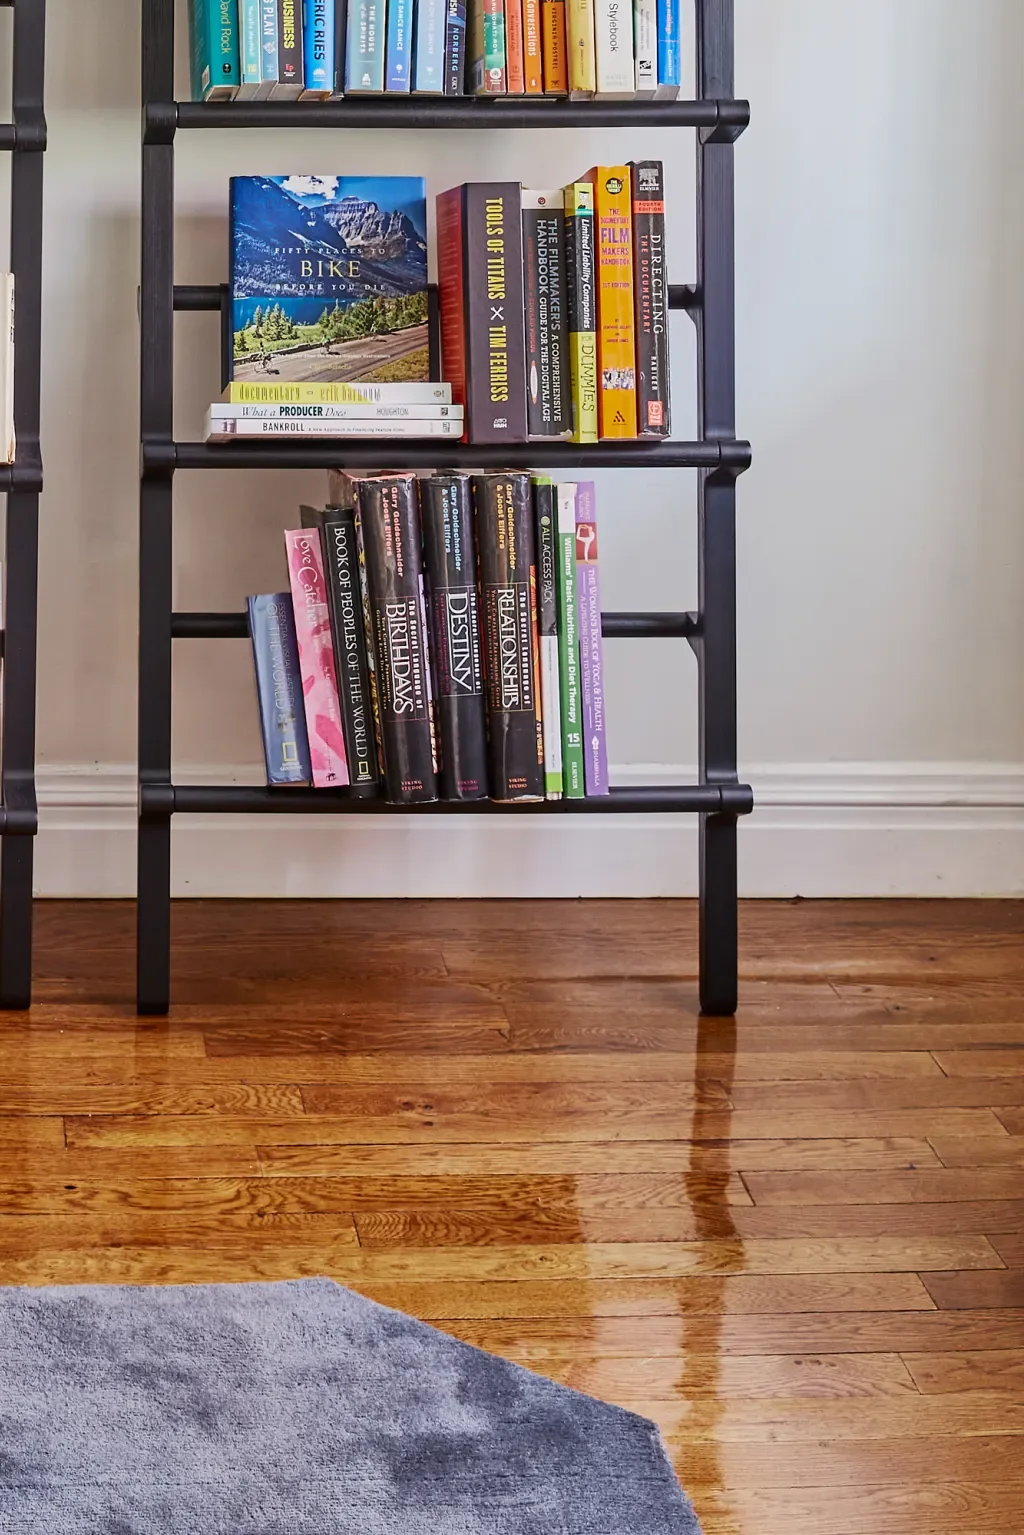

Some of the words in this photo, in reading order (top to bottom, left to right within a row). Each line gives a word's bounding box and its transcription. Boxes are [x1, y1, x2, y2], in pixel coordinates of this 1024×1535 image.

[263, 7, 273, 35] PLAN
[527, 0, 537, 56] Conversations
[608, 3, 619, 52] Stylebook
[221, 29, 231, 54] Rock
[315, 30, 326, 60] RIES
[486, 198, 503, 235] TOOLS
[548, 219, 558, 243] THE
[581, 219, 590, 248] Limited
[486, 239, 504, 252] OF
[537, 220, 549, 293] HANDBOOK
[300, 260, 361, 278] BIKE
[487, 257, 505, 299] TITANS
[581, 250, 591, 281] Liability
[549, 248, 560, 330] FILMMAKER'S
[641, 260, 650, 334] DOCUMENTARY
[650, 235, 663, 334] DIRECTING
[582, 283, 591, 328] Companies
[489, 326, 506, 348] TIM
[490, 352, 508, 402] FERRISS
[582, 345, 595, 411] DUMMIES
[263, 422, 305, 432] BANKROLL
[280, 406, 323, 417] PRODUCER
[334, 527, 349, 568] BOOK
[542, 527, 550, 542] ALL
[543, 544, 552, 578] ACCESS
[338, 570, 352, 589] OF
[544, 580, 552, 603] PACK
[340, 591, 357, 650] PEOPLES
[567, 604, 575, 646] Nutrition
[385, 603, 413, 714] BIRTHDAYS
[447, 592, 471, 691] DESTINY
[497, 589, 519, 708] RELATIONSHIPS
[348, 652, 361, 671] OF
[350, 672, 363, 704] THE
[568, 687, 577, 723] Therapy
[353, 706, 367, 757] WORLD
